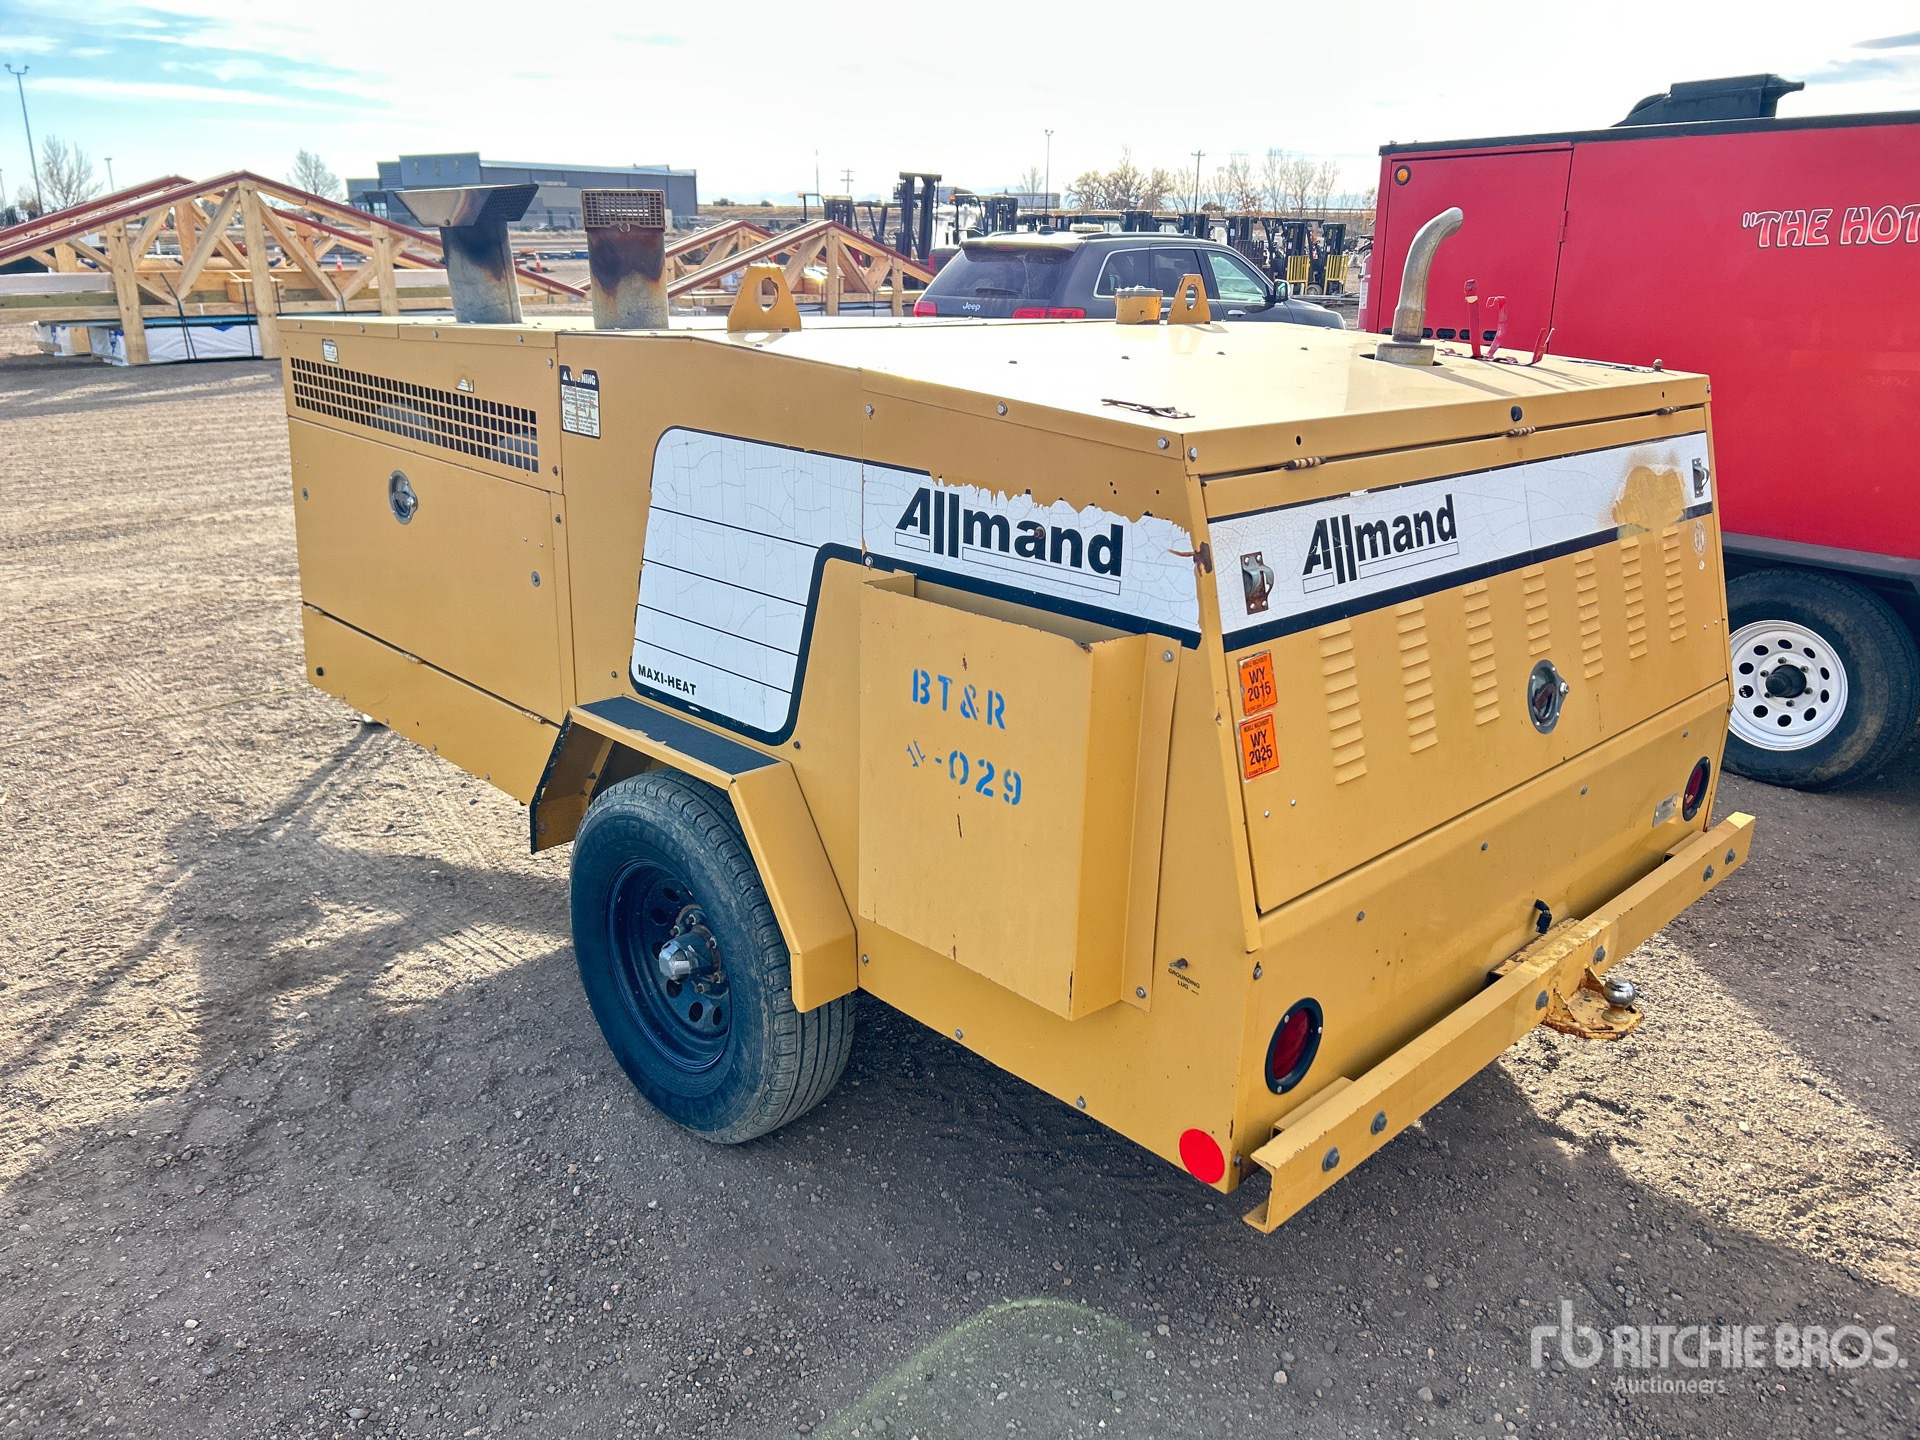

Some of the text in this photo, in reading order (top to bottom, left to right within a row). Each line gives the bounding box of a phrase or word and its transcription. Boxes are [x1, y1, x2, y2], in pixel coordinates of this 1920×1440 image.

[1839, 204, 1920, 245] HOT
[962, 301, 981, 311] Jeep
[896, 487, 1124, 577] Allmand
[1302, 493, 1457, 585] Allmand
[638, 664, 697, 696] MAXI-HEAT
[1248, 666, 1266, 684] WY
[1247, 681, 1272, 702] 2015
[1249, 729, 1268, 748] WY
[1248, 744, 1273, 766] 2025
[1167, 968, 1200, 989] GROUNDING
[1177, 979, 1189, 990] LUG
